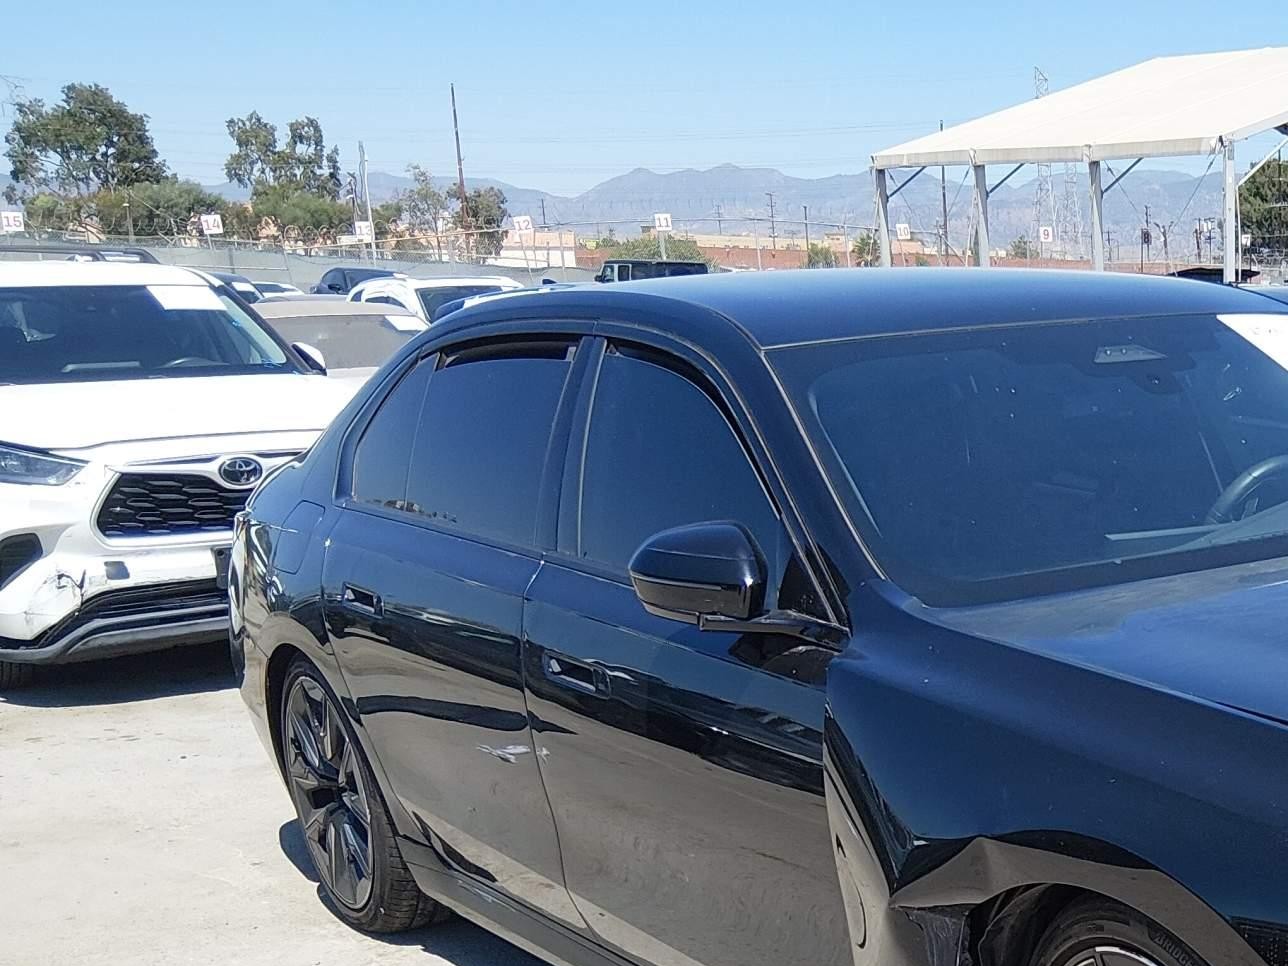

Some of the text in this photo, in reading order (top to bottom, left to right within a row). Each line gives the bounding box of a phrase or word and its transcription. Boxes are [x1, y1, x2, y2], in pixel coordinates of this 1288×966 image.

[3, 216, 23, 228] 15
[205, 217, 221, 231] 14
[515, 218, 530, 231] 12
[656, 217, 671, 228] 11
[898, 226, 909, 237] 10
[1043, 229, 1049, 240] 9
[1143, 230, 1150, 244] 8
[1243, 236, 1250, 246] 7
